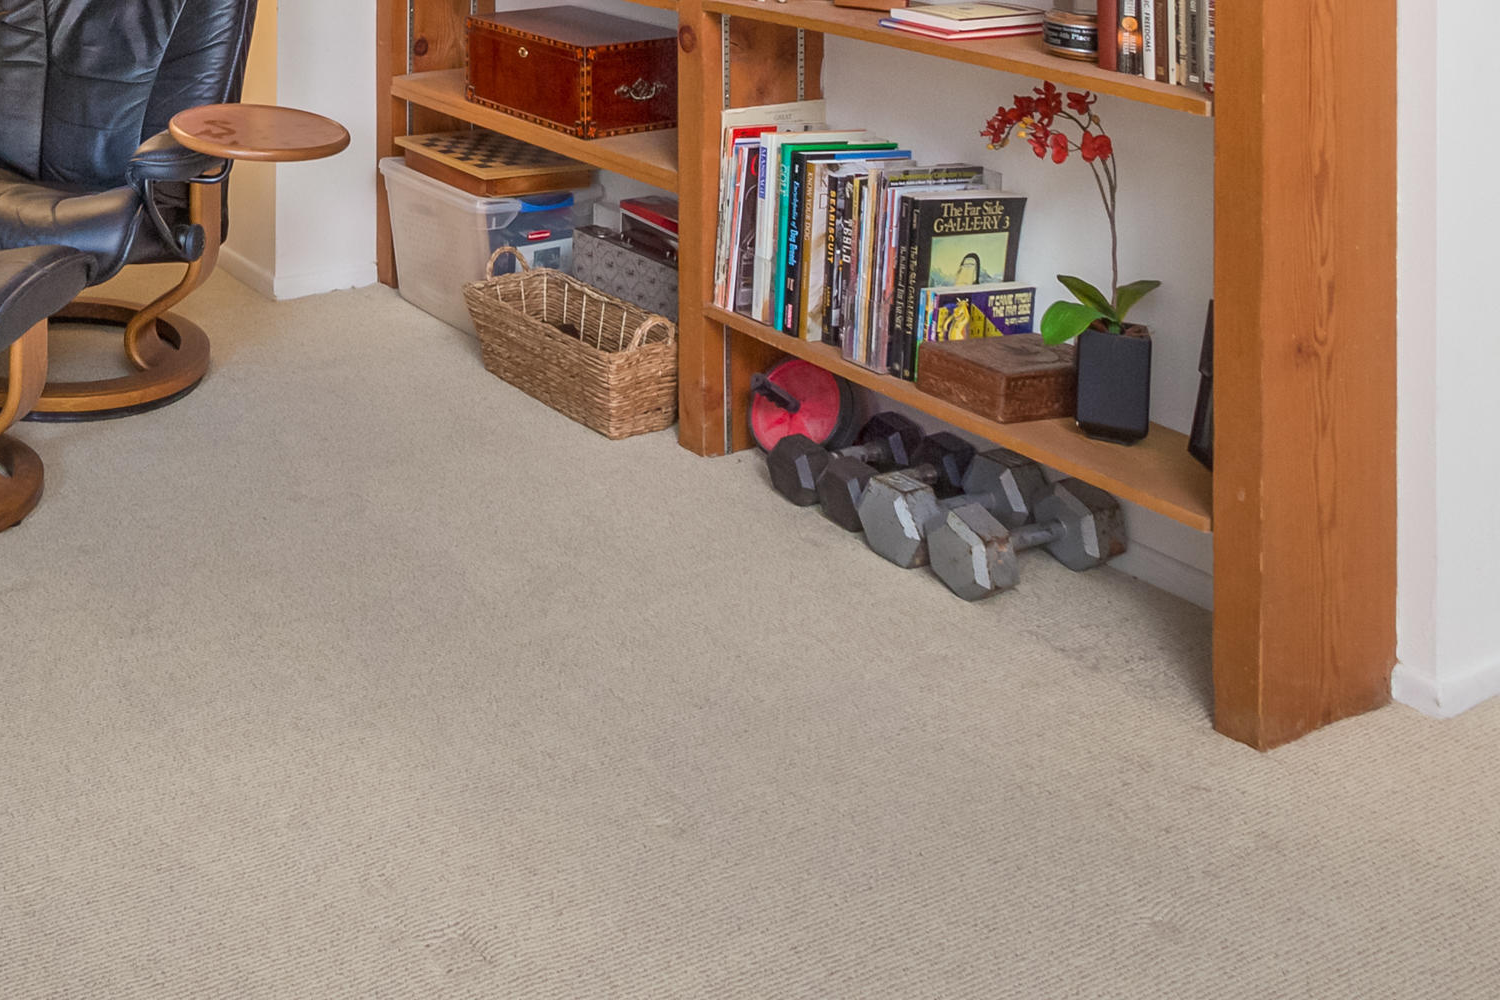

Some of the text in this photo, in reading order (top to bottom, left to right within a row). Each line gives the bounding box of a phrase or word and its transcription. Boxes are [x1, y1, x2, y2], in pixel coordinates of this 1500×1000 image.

[1143, 12, 1151, 53] FREEDOMS
[791, 181, 800, 220] Encyclopedia
[804, 198, 812, 220] YOUR
[941, 200, 1005, 218] The Far Side
[803, 221, 812, 241] DOG
[826, 190, 837, 265] SEABISCUIT
[1003, 215, 1010, 229] 3
[789, 229, 799, 243] Dog
[788, 243, 798, 266] Breeds
